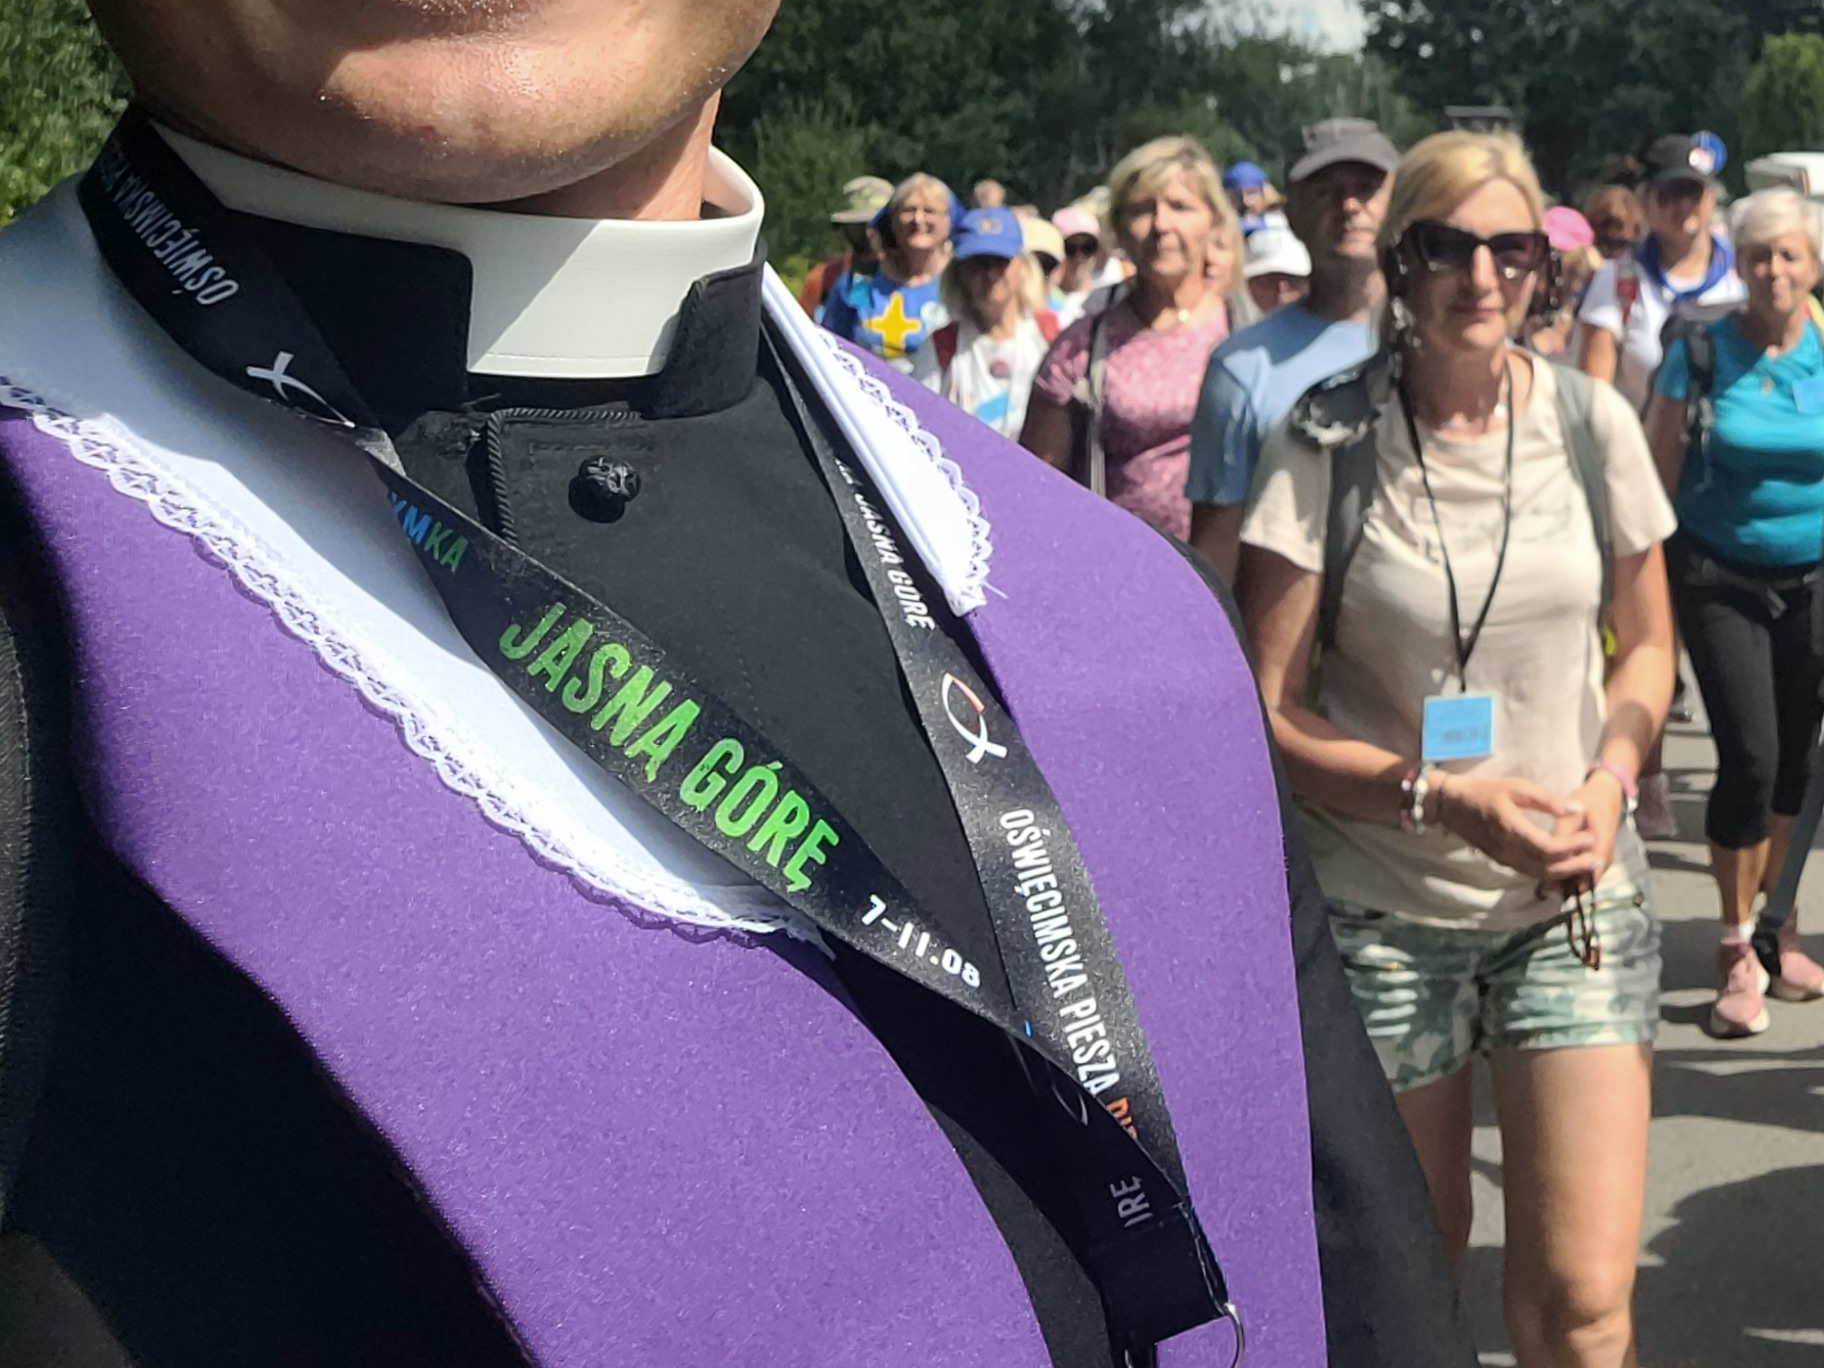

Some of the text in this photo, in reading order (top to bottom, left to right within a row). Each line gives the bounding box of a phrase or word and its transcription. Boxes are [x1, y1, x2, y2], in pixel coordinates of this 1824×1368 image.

[680, 738, 840, 893] GÓRĘ
[861, 893, 981, 988] 7-11.08
[1000, 808, 1120, 1098] OŚWIĘCIMSKA PIESZA
